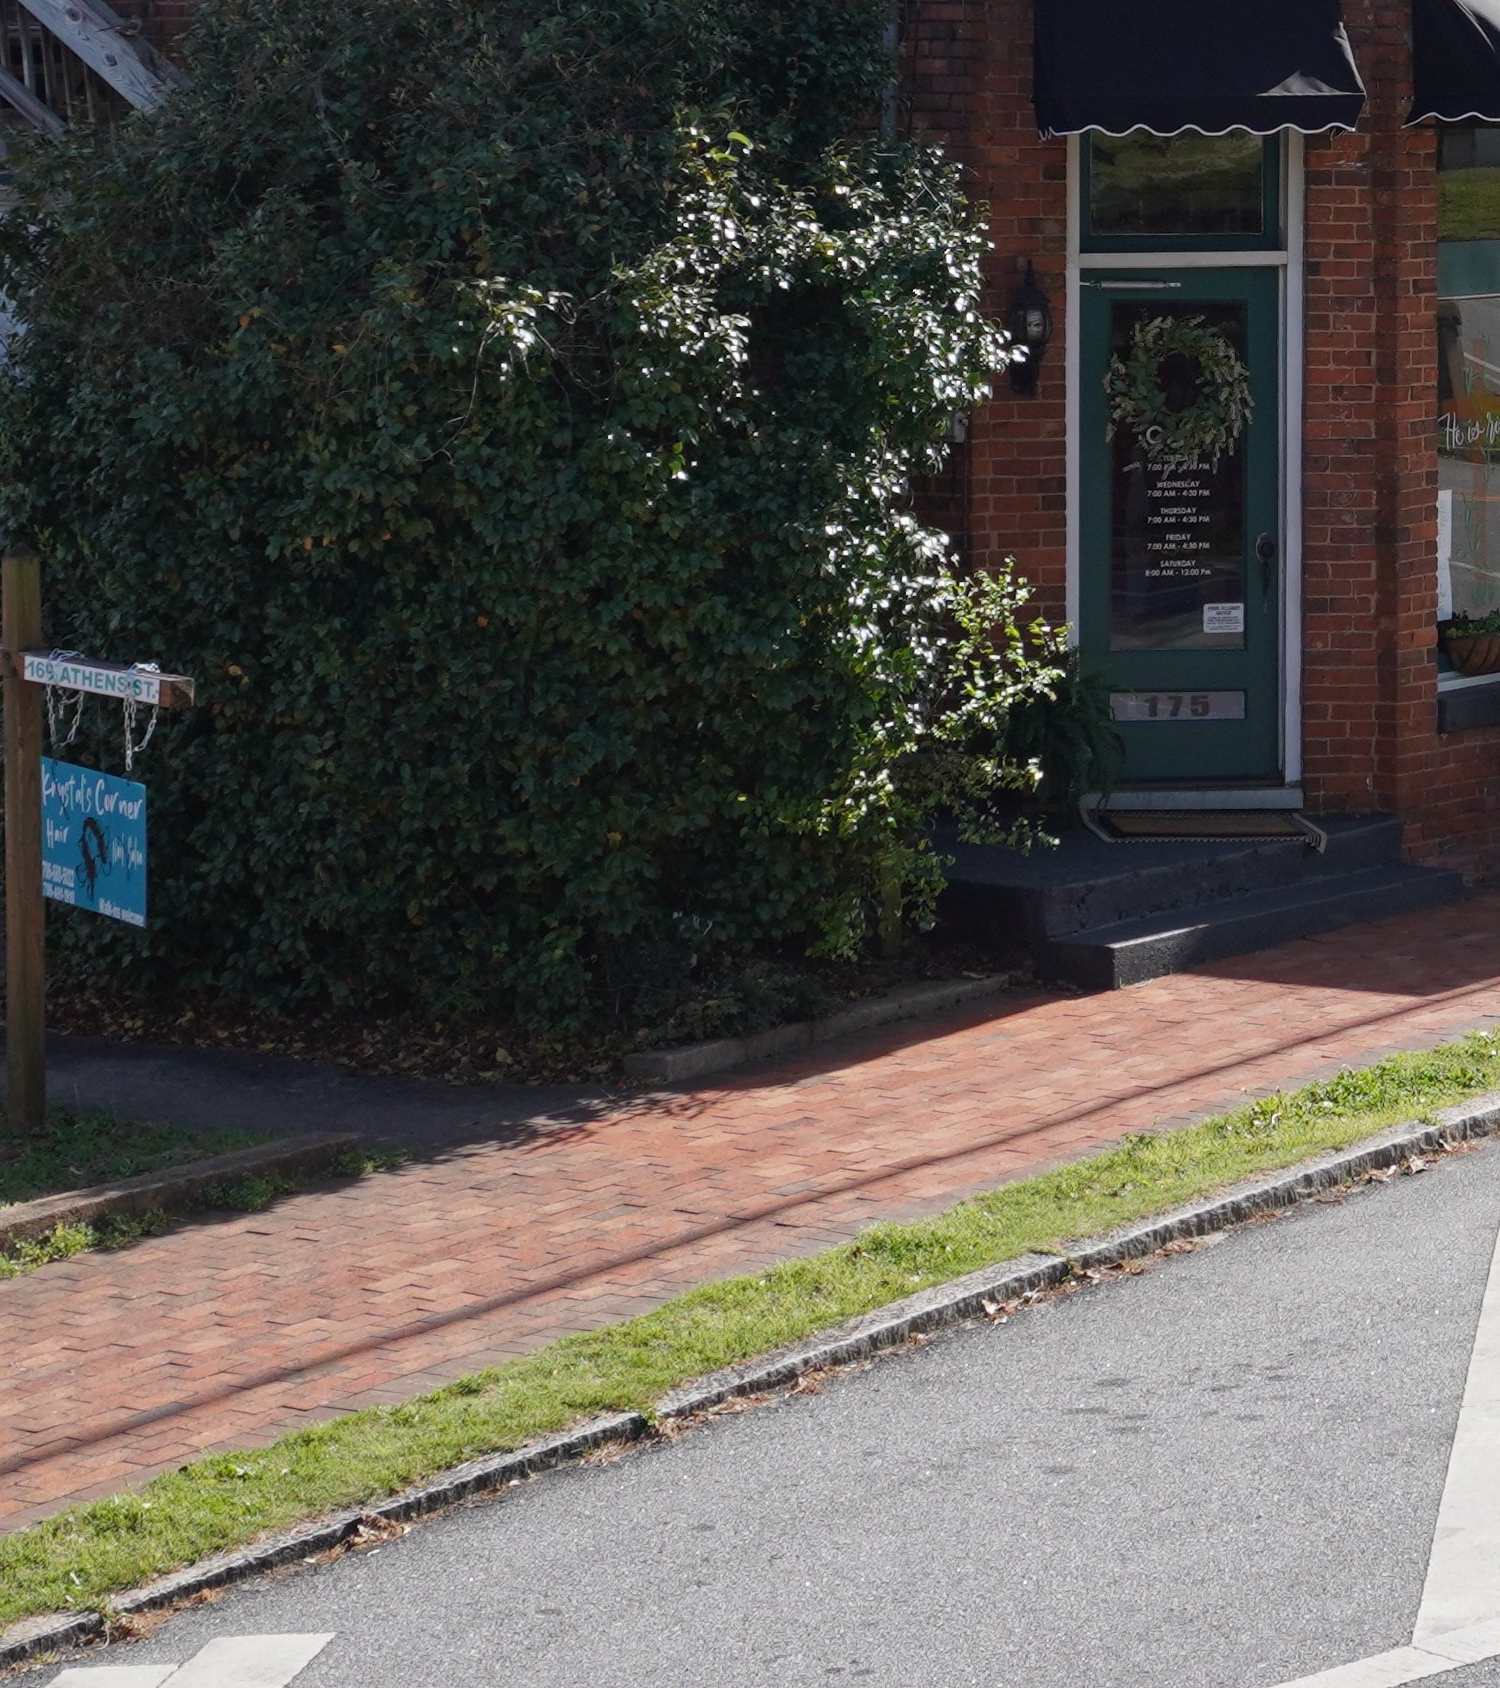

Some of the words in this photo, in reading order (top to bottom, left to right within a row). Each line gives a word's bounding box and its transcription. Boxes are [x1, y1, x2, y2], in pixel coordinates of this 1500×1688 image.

[1438, 412, 1464, 451] He
[60, 668, 127, 694] ATHENS
[1144, 695, 1210, 718] 175
[94, 778, 143, 820] Corner
[46, 817, 69, 850] Hair
